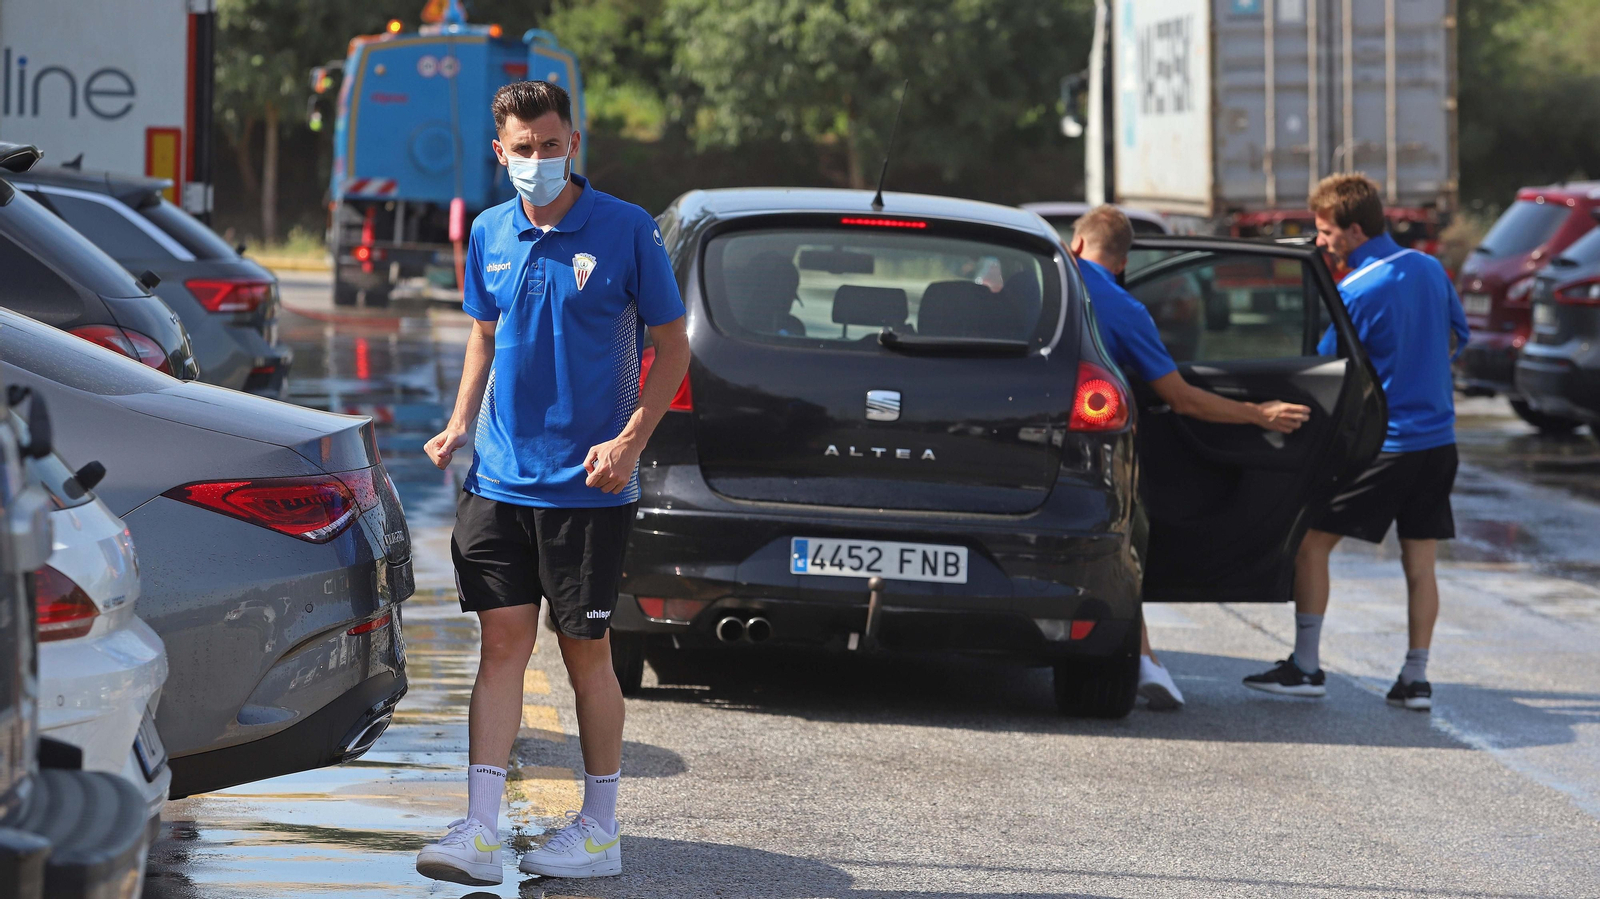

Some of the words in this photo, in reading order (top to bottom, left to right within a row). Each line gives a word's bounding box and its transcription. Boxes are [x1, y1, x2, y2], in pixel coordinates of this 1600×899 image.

[3, 46, 136, 121] line
[486, 262, 511, 273] uhlsport
[824, 444, 936, 461] ALTEA
[810, 543, 883, 573] 4452
[899, 548, 960, 577] FNB
